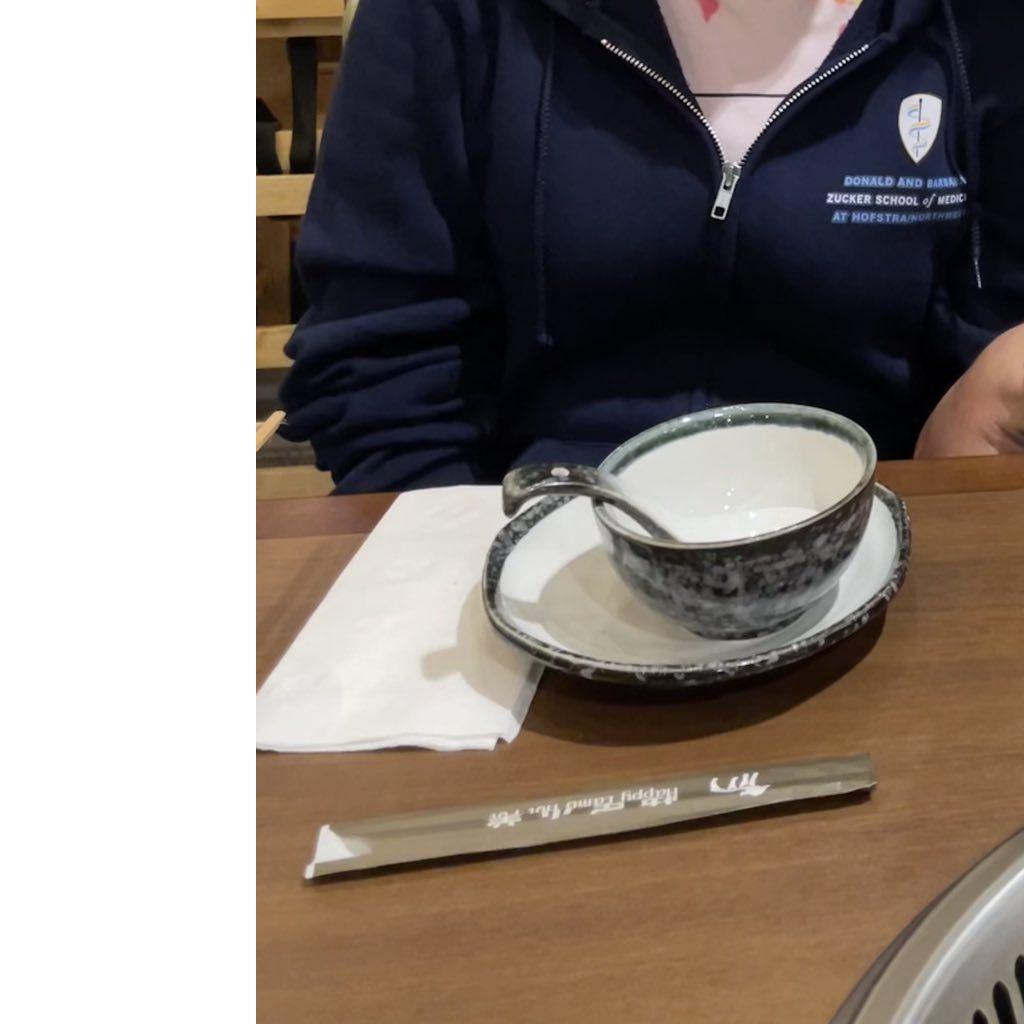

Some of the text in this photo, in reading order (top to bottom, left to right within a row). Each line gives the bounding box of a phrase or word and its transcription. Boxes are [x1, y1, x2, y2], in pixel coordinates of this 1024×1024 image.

[843, 175, 894, 187] DONALD
[896, 176, 923, 188] AND
[826, 192, 871, 205] ZUCKER
[874, 194, 919, 206] SCHOOL
[922, 193, 936, 208] of
[831, 211, 847, 223] AT
